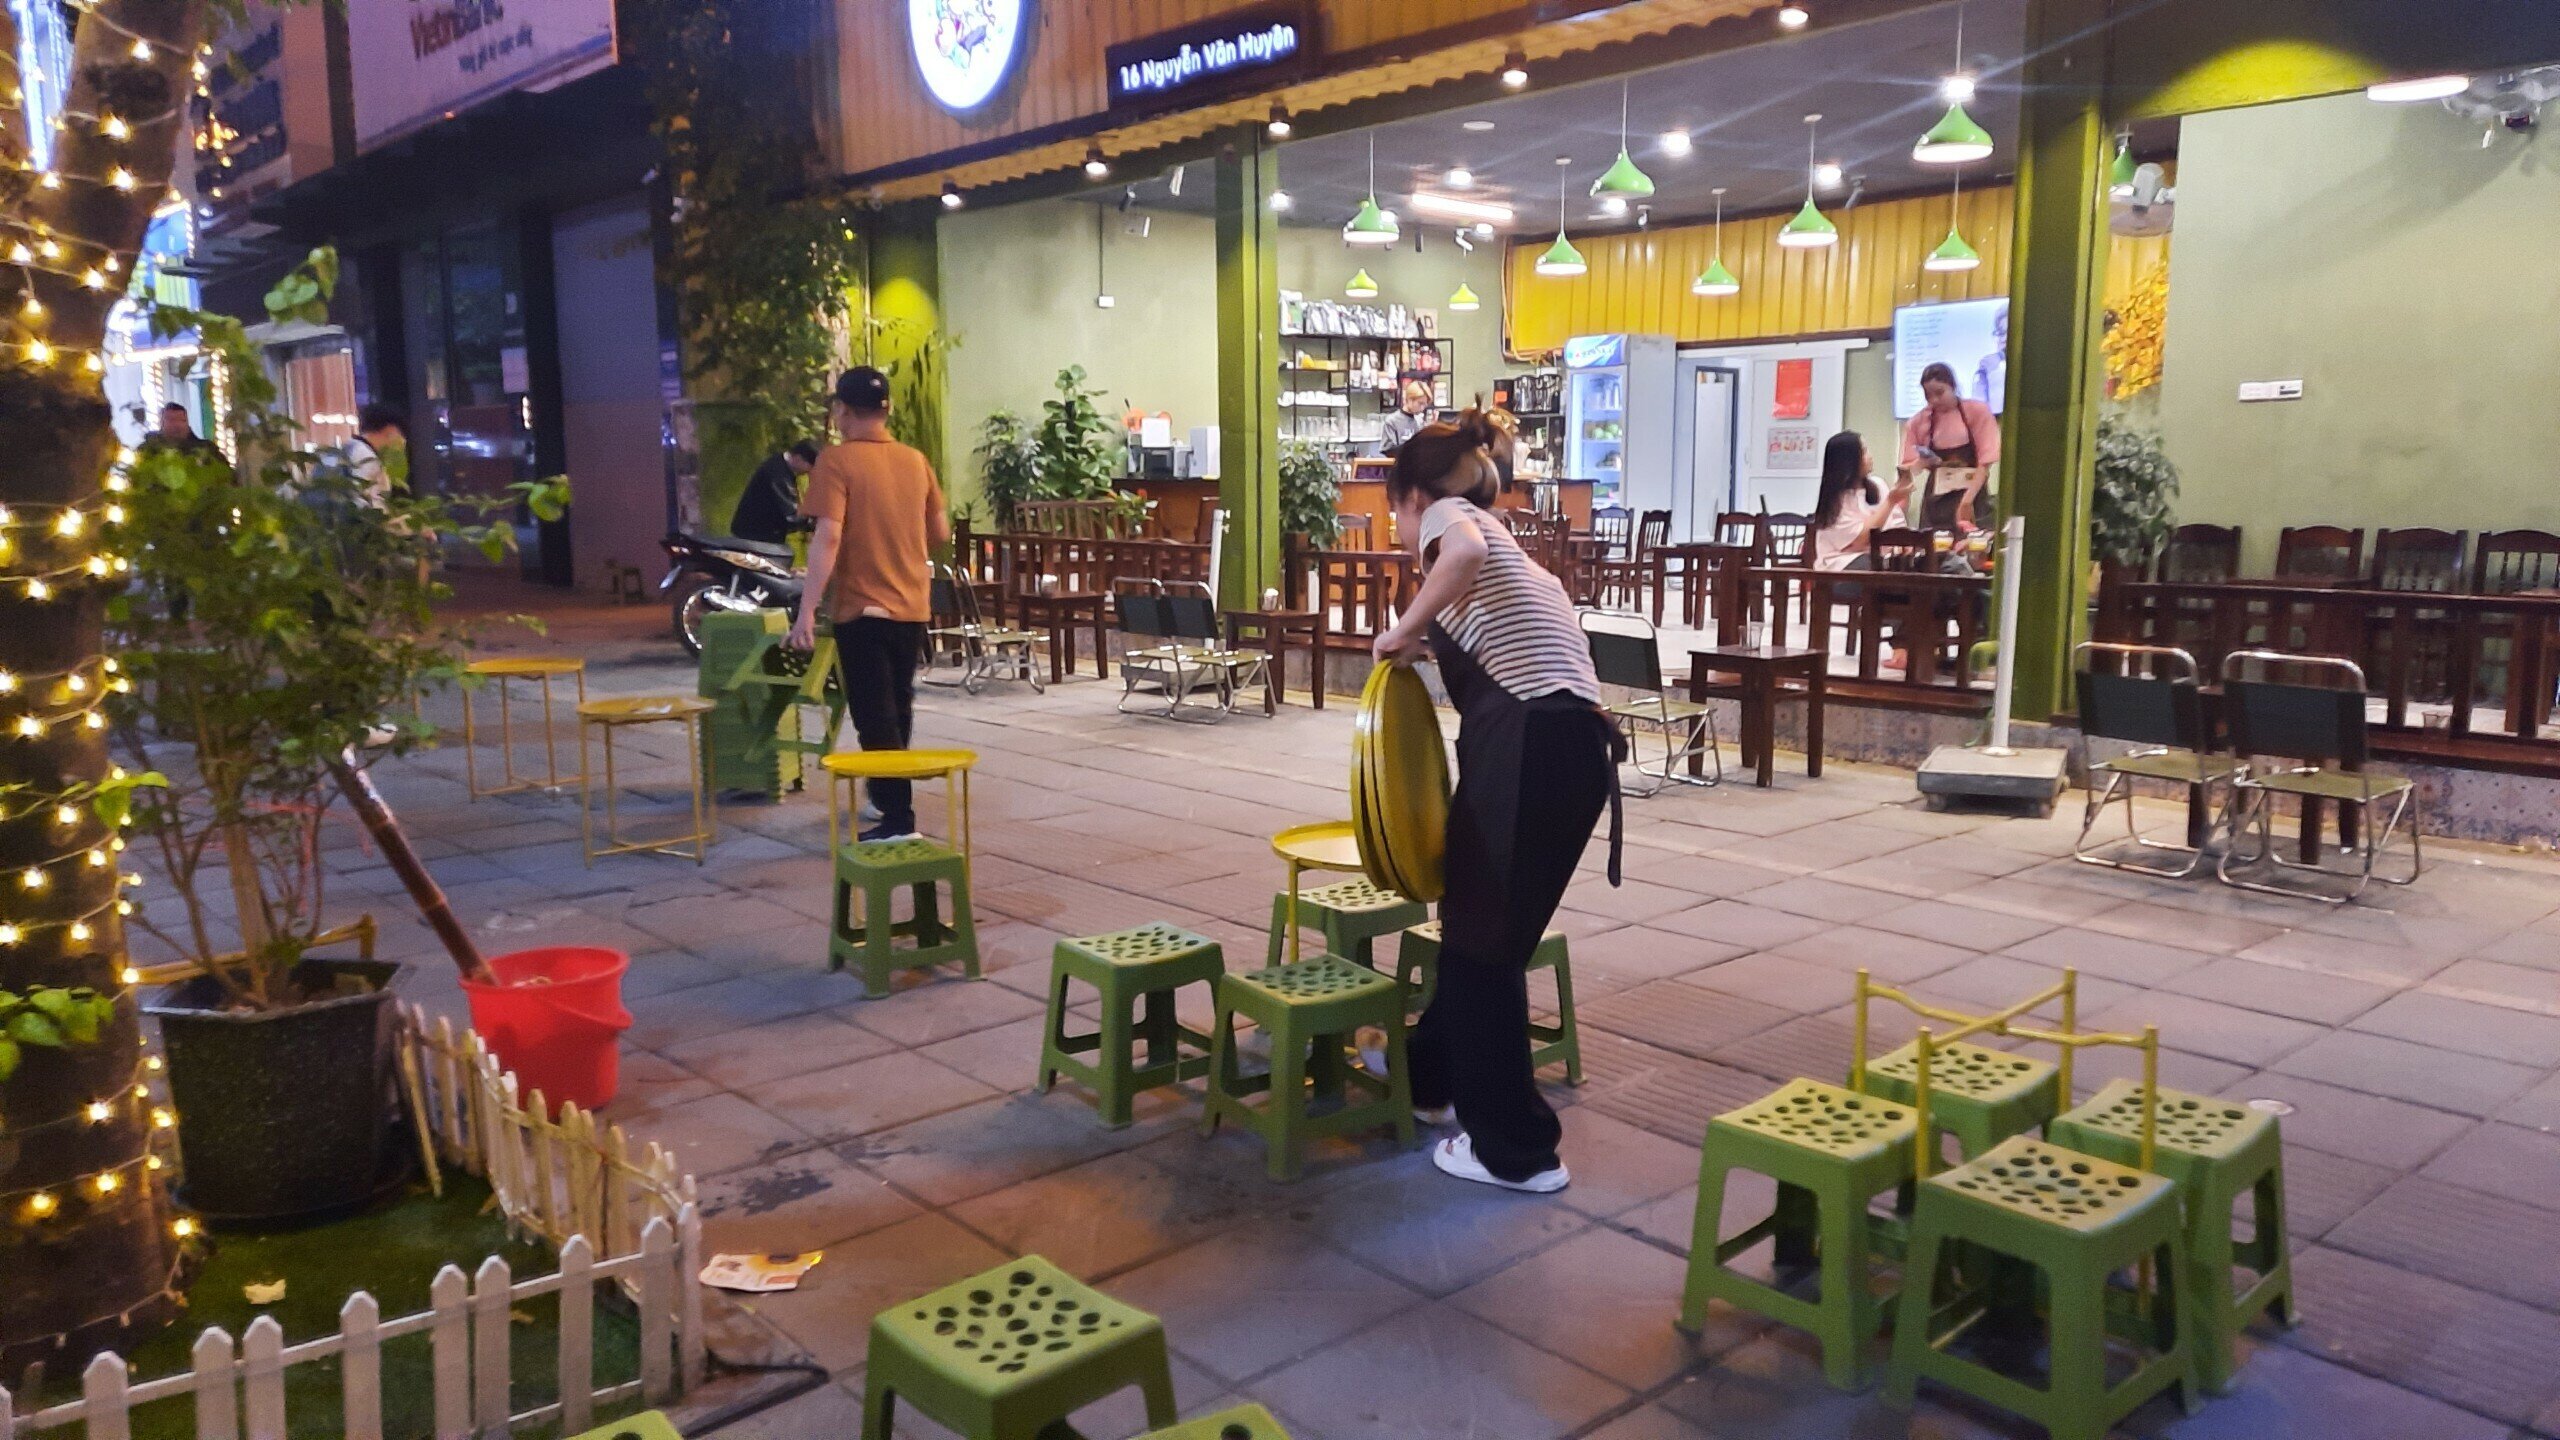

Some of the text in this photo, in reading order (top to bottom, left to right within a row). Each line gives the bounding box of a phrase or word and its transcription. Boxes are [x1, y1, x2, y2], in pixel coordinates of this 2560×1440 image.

[1120, 64, 1141, 90] 16
[1142, 43, 1201, 88] Nguyễn
[1202, 39, 1237, 69] Văn
